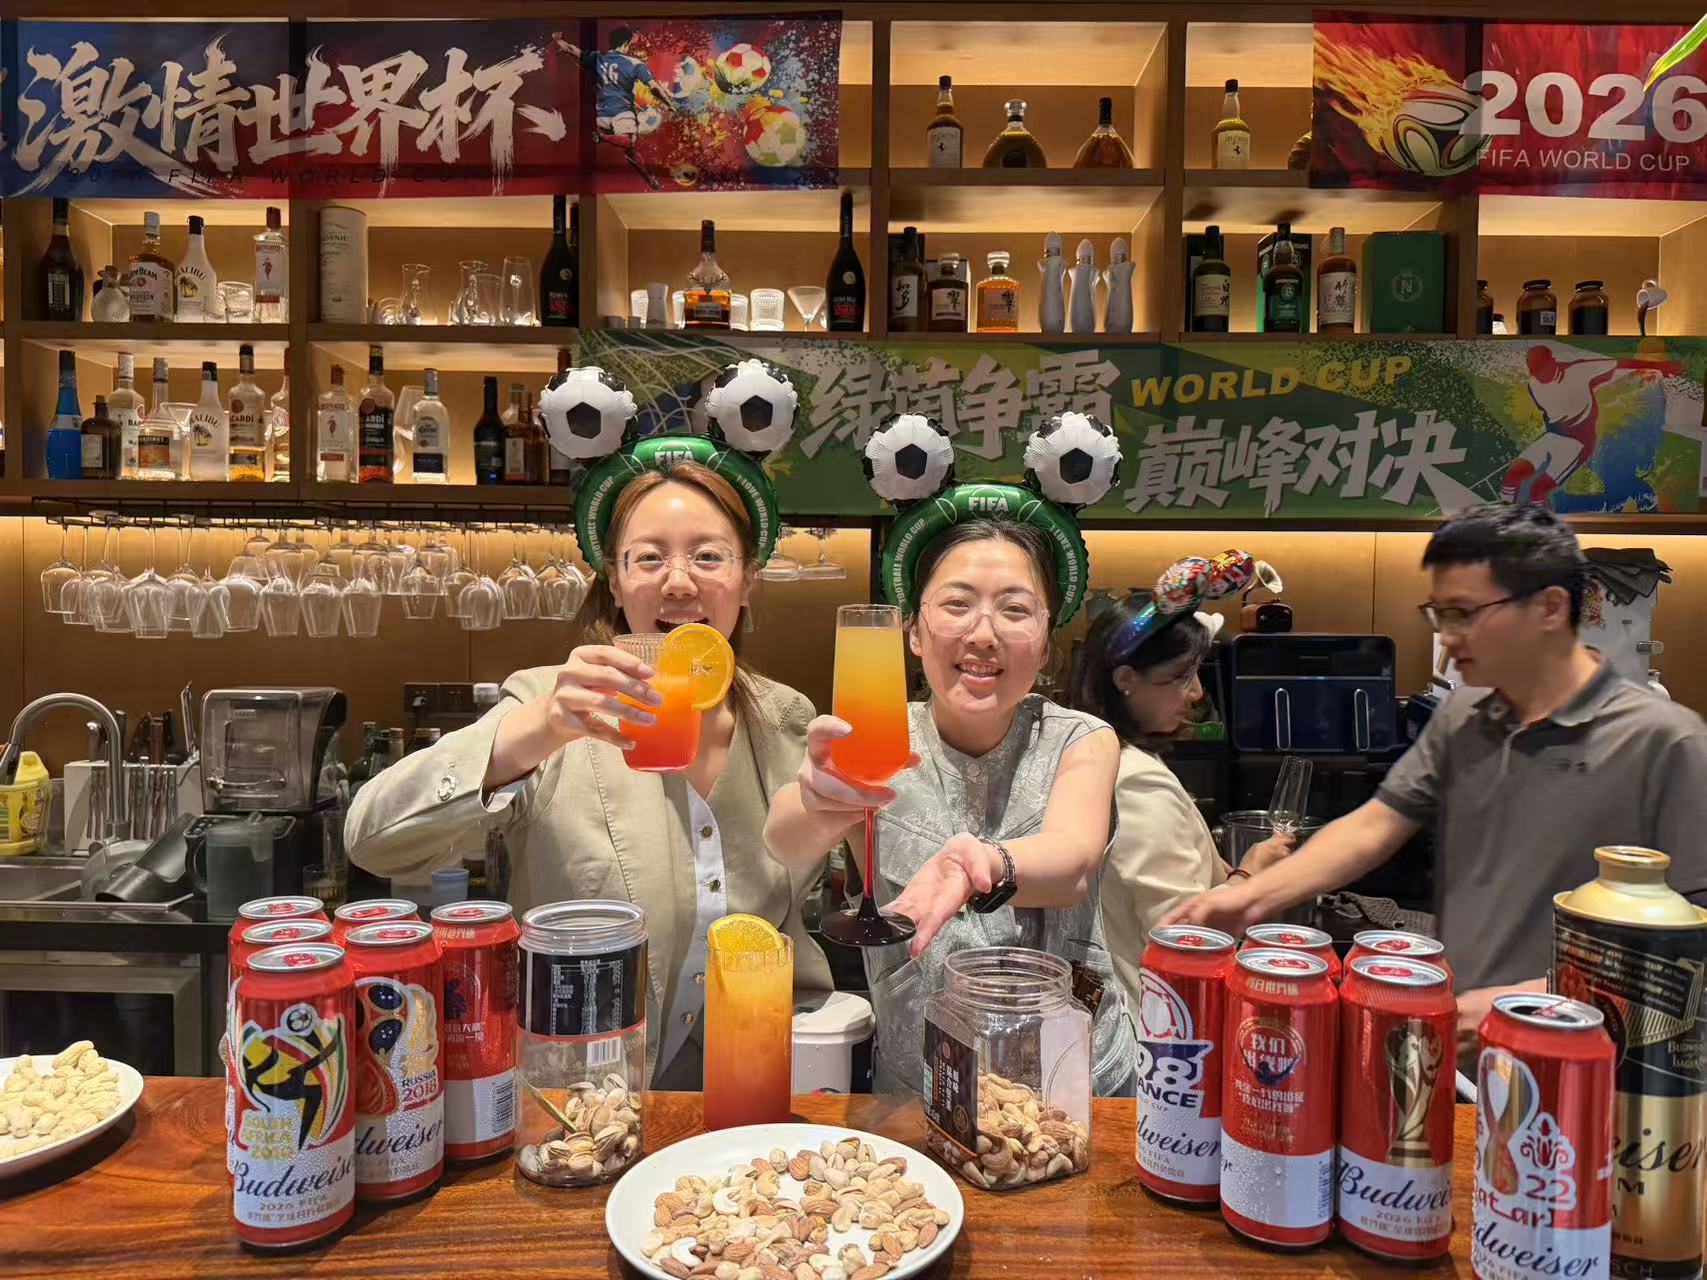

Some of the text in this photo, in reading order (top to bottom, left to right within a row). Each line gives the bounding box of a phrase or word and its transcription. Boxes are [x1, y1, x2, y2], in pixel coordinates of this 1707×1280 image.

[11, 33, 567, 197] 激情世界杯
[1459, 70, 1707, 143] 2026
[1477, 148, 1691, 172] FIFA WORLD CUP
[1130, 355, 1413, 408] WORLD CUP
[654, 450, 695, 466] FIFA
[1124, 409, 1487, 518] 巅峰对决
[599, 475, 614, 494] CUP
[741, 479, 760, 498] LOVE
[968, 496, 1010, 512] FIFA
[895, 533, 913, 561] WORLD
[909, 518, 925, 535] CUP
[1053, 528, 1072, 550] LOVE
[1066, 550, 1078, 582] WORLD
[1065, 583, 1076, 604] CUP
[401, 1079, 437, 1101] 2018
[1137, 1076, 1199, 1109] ANCE
[354, 1117, 444, 1159] dweiser
[1338, 1160, 1452, 1212] Budwei
[1524, 1173, 1572, 1204] 22
[1474, 1221, 1600, 1278] dweiser
